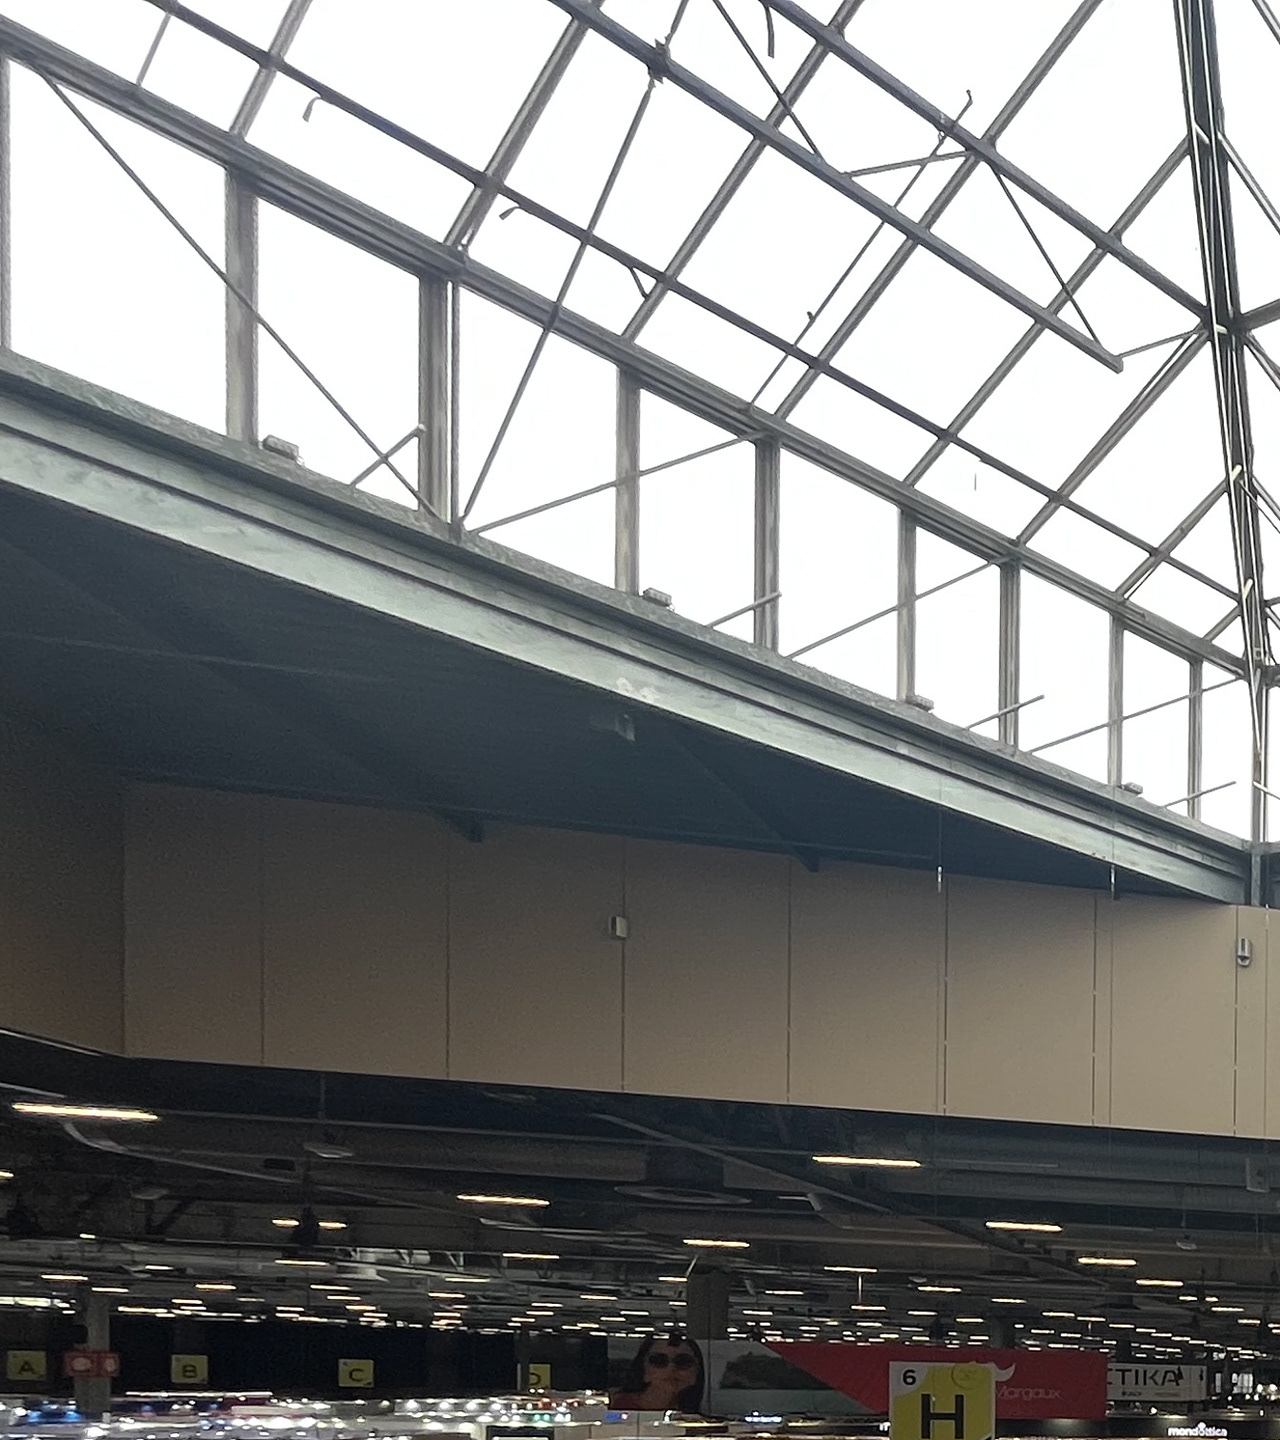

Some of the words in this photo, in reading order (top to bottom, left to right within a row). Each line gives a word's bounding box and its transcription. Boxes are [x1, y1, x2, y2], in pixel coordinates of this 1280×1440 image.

[18, 1360, 36, 1375] A
[182, 1364, 198, 1379] B
[350, 1368, 361, 1381] C
[902, 1368, 917, 1385] 6
[921, 1393, 965, 1440] H
[1167, 1423, 1228, 1438] mondottica
